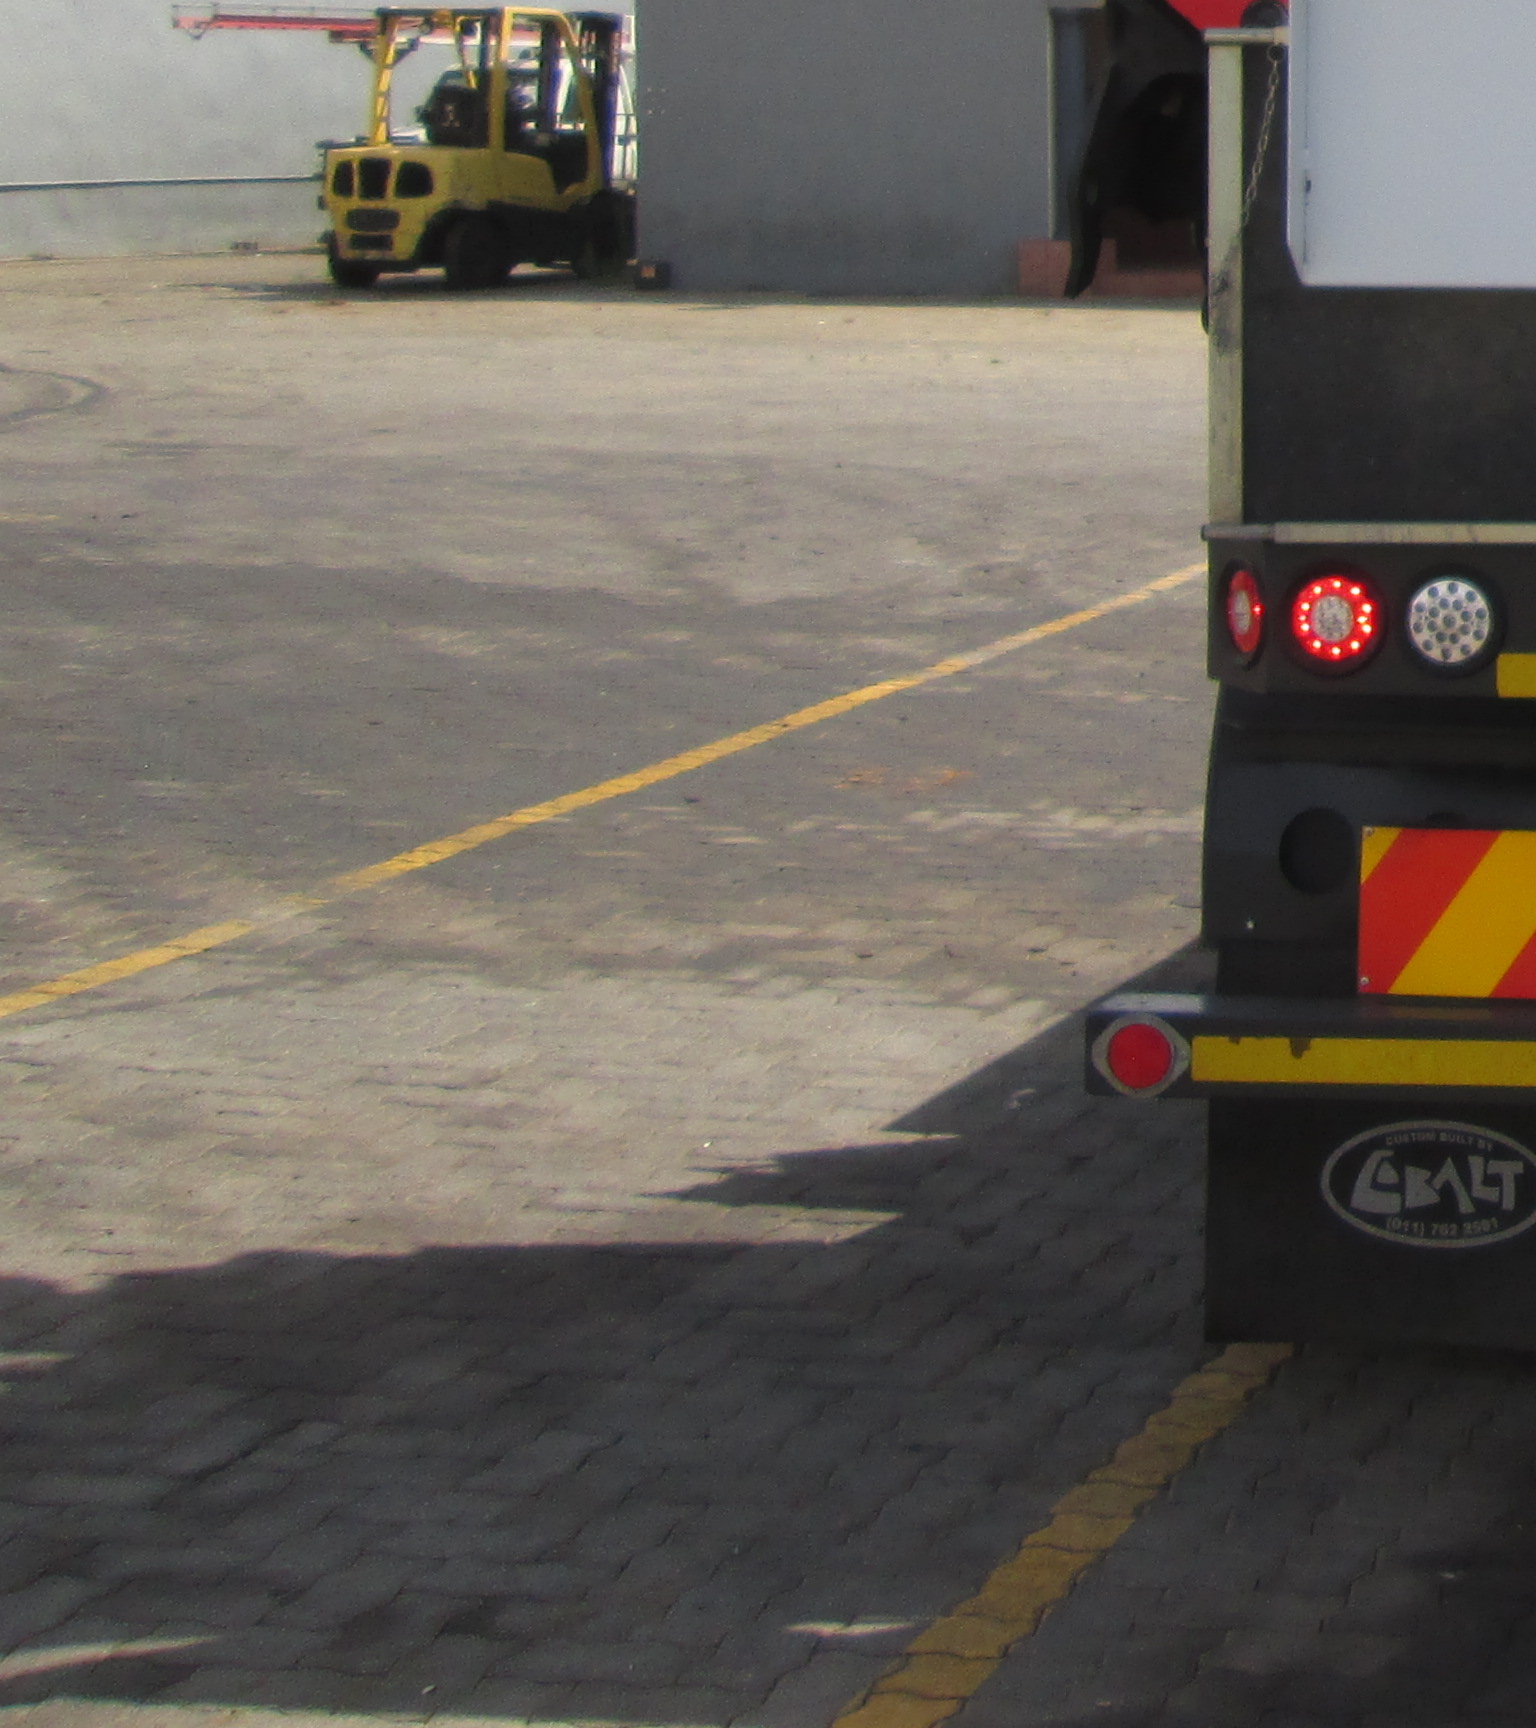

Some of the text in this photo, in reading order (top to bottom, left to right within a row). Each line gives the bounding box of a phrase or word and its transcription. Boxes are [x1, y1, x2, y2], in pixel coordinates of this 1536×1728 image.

[1385, 1130, 1494, 1152] CUSTOM BUILT BY
[1385, 1216, 1425, 1238] (011)
